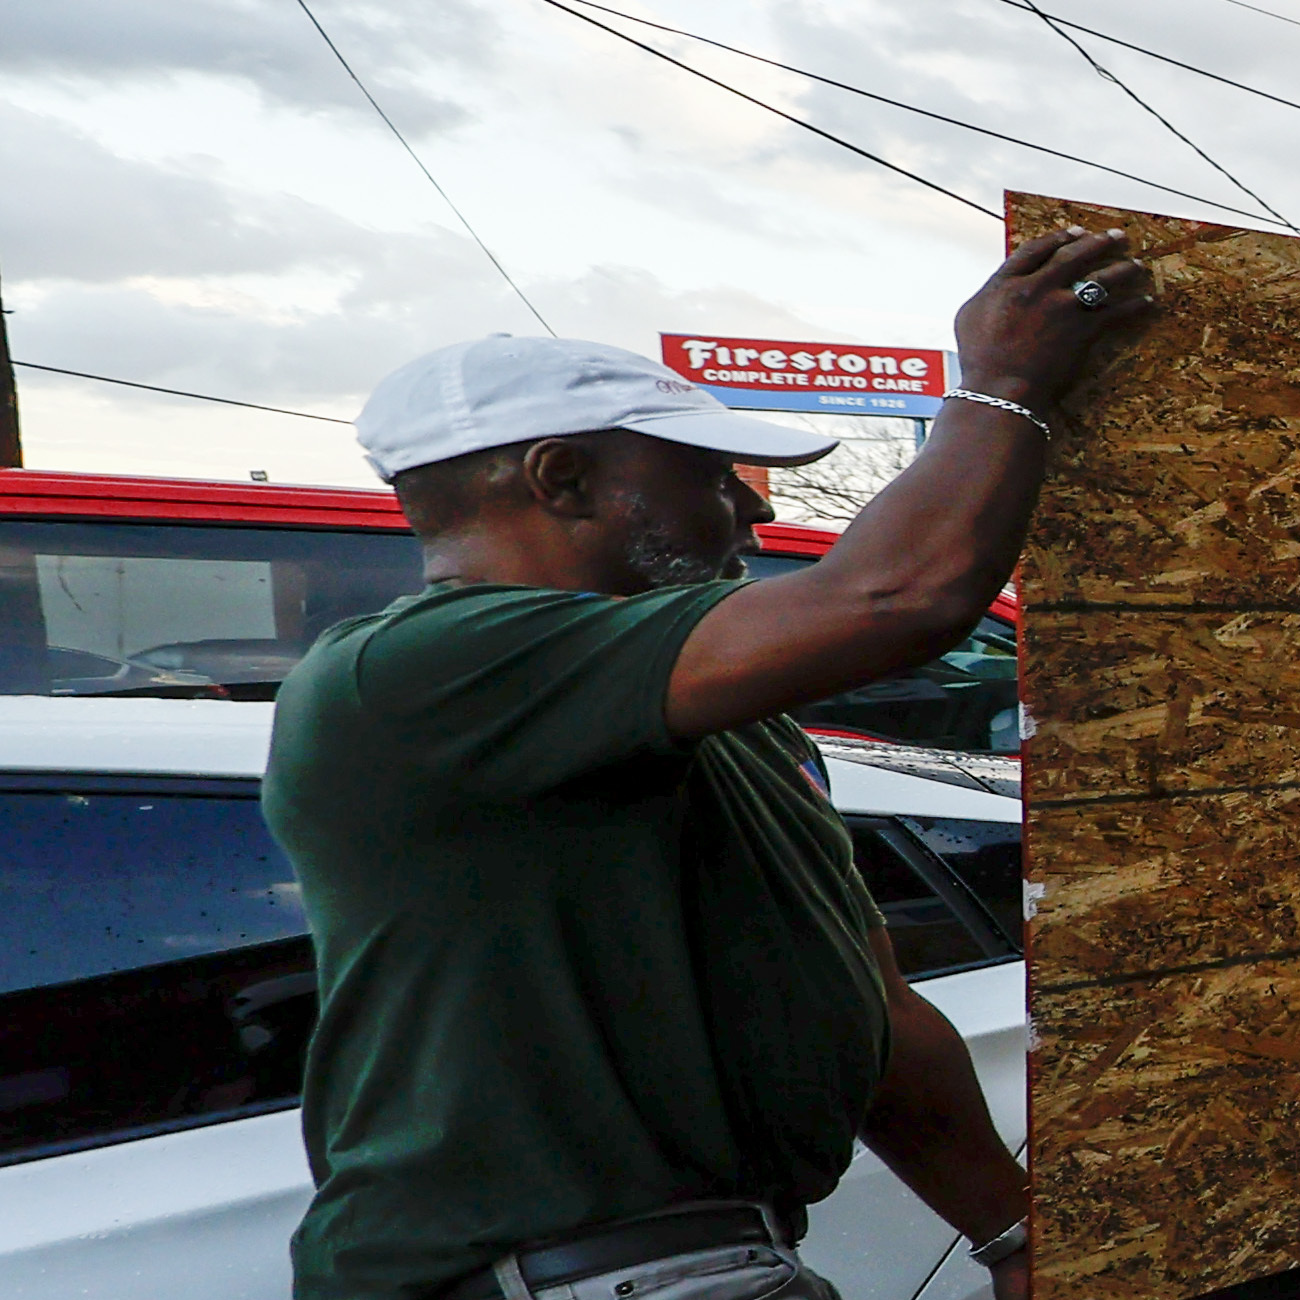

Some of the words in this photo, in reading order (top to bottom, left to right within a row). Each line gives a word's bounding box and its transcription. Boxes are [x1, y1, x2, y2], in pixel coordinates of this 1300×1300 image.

[681, 340, 928, 378] Firestone
[703, 368, 809, 386] COMPLETE
[814, 375, 867, 388] AUTO
[872, 379, 924, 392] CARE
[818, 395, 866, 407] SINCE
[870, 398, 906, 409] 1926
